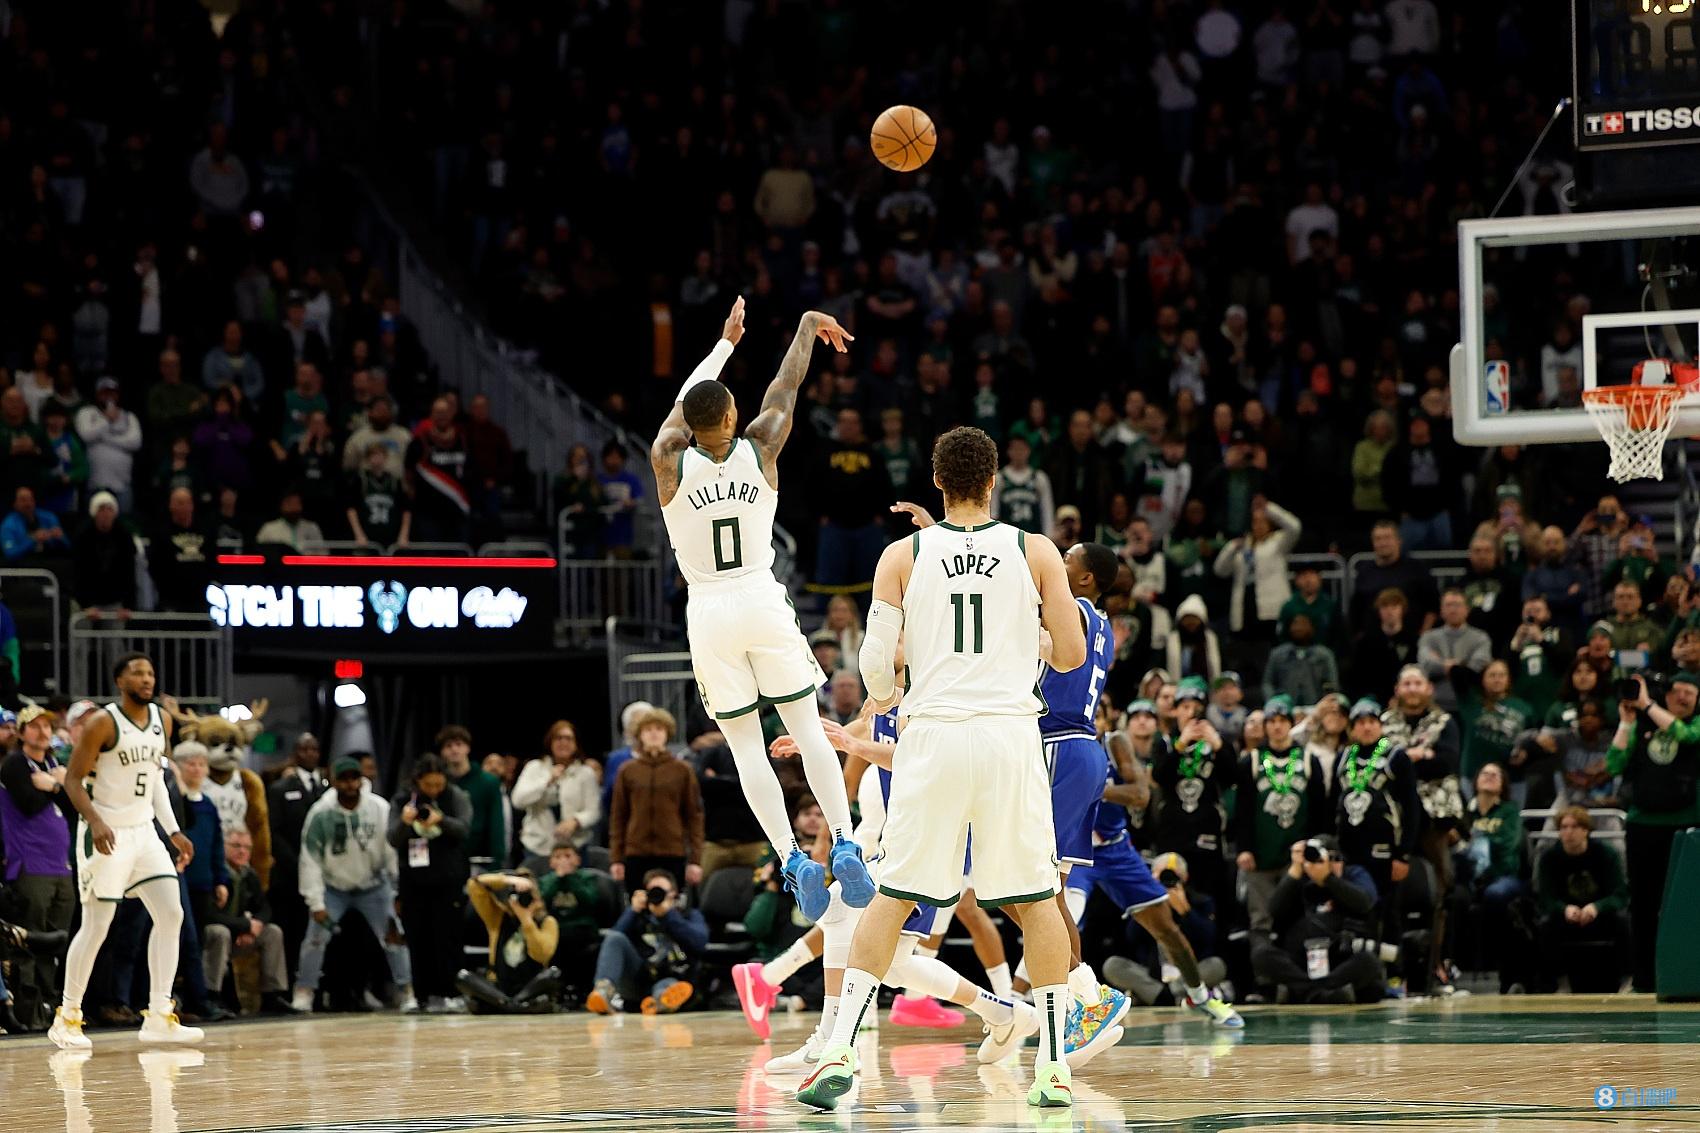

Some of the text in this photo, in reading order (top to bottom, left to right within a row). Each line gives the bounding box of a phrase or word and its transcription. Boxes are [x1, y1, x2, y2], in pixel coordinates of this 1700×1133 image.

[688, 481, 759, 510] LILLARD
[712, 517, 742, 571] 0
[941, 554, 1000, 578] LOPEZ
[298, 586, 363, 627] THE
[408, 587, 458, 628] ON
[951, 593, 983, 653] 11
[1083, 664, 1106, 720] 5
[135, 773, 147, 796] 5
